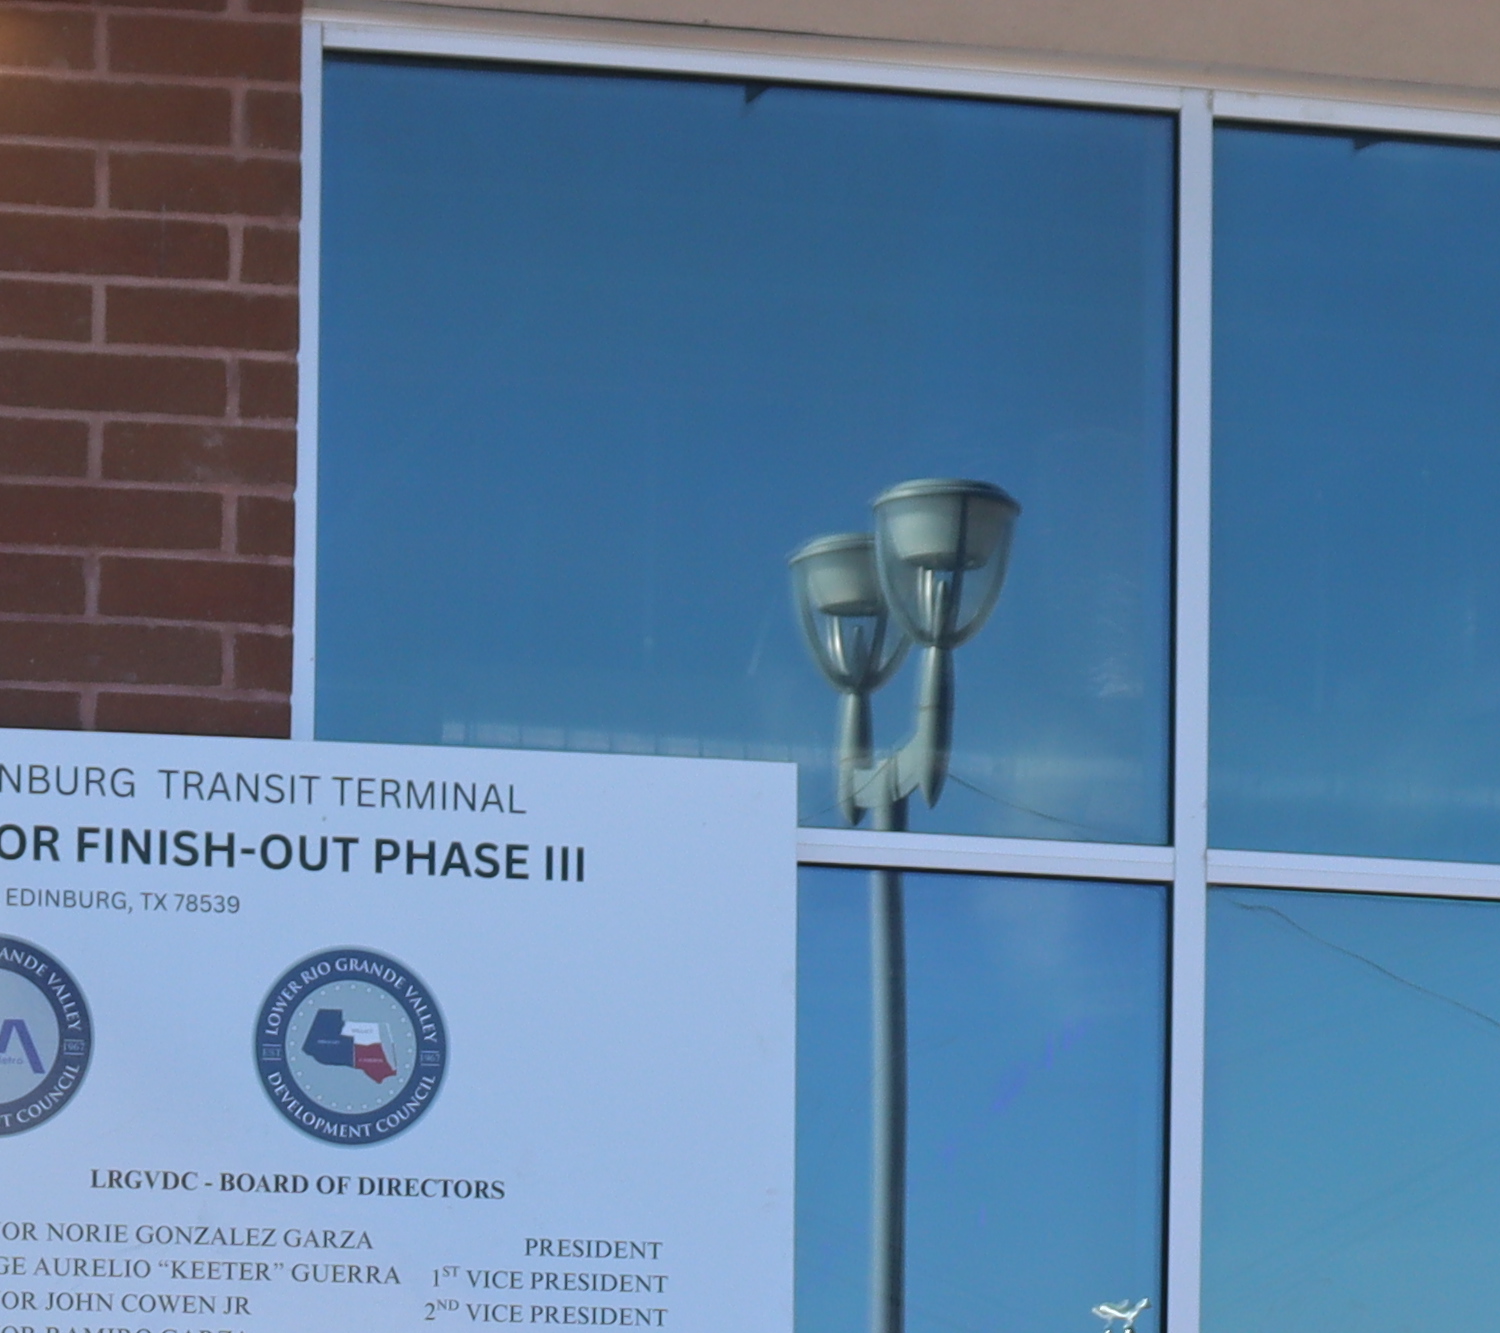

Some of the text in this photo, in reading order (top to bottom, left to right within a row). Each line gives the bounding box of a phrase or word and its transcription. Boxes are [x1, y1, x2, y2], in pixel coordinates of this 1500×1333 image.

[156, 768, 322, 806] TRANSIT
[331, 775, 528, 815] TERMINAL
[76, 825, 360, 874] FINISH-OUT
[374, 837, 530, 881] PHASE
[544, 844, 585, 883] III
[5, 887, 133, 914] EDINBURG,
[139, 891, 168, 912] TX
[174, 893, 241, 915] 78539
[46, 972, 83, 1031] VALLEY
[265, 957, 438, 1043] LOWER RIO GRANDE VALLEY
[16, 1063, 81, 1123] COUNCIL
[267, 1071, 436, 1138] DEVELOPMENT COUNCIL
[90, 1168, 199, 1192] LRGVDC
[219, 1172, 310, 1194] BOARD
[315, 1174, 352, 1196] OF
[357, 1176, 506, 1200] DIRECTORS
[46, 1222, 129, 1244] NORIE
[135, 1224, 277, 1248] GONZALEZ
[282, 1228, 374, 1250] GARZA
[524, 1237, 663, 1261] PRESIDENT
[33, 1257, 152, 1279] AURELIO
[290, 1263, 401, 1285] GUERRA
[433, 1265, 669, 1294] 1ST VICE PRESIDENT
[44, 1291, 113, 1312] JOHN
[120, 1293, 216, 1315] COWEN
[222, 1295, 251, 1316] JR
[424, 1299, 669, 1327] 2ND VICE PRESIDENT
